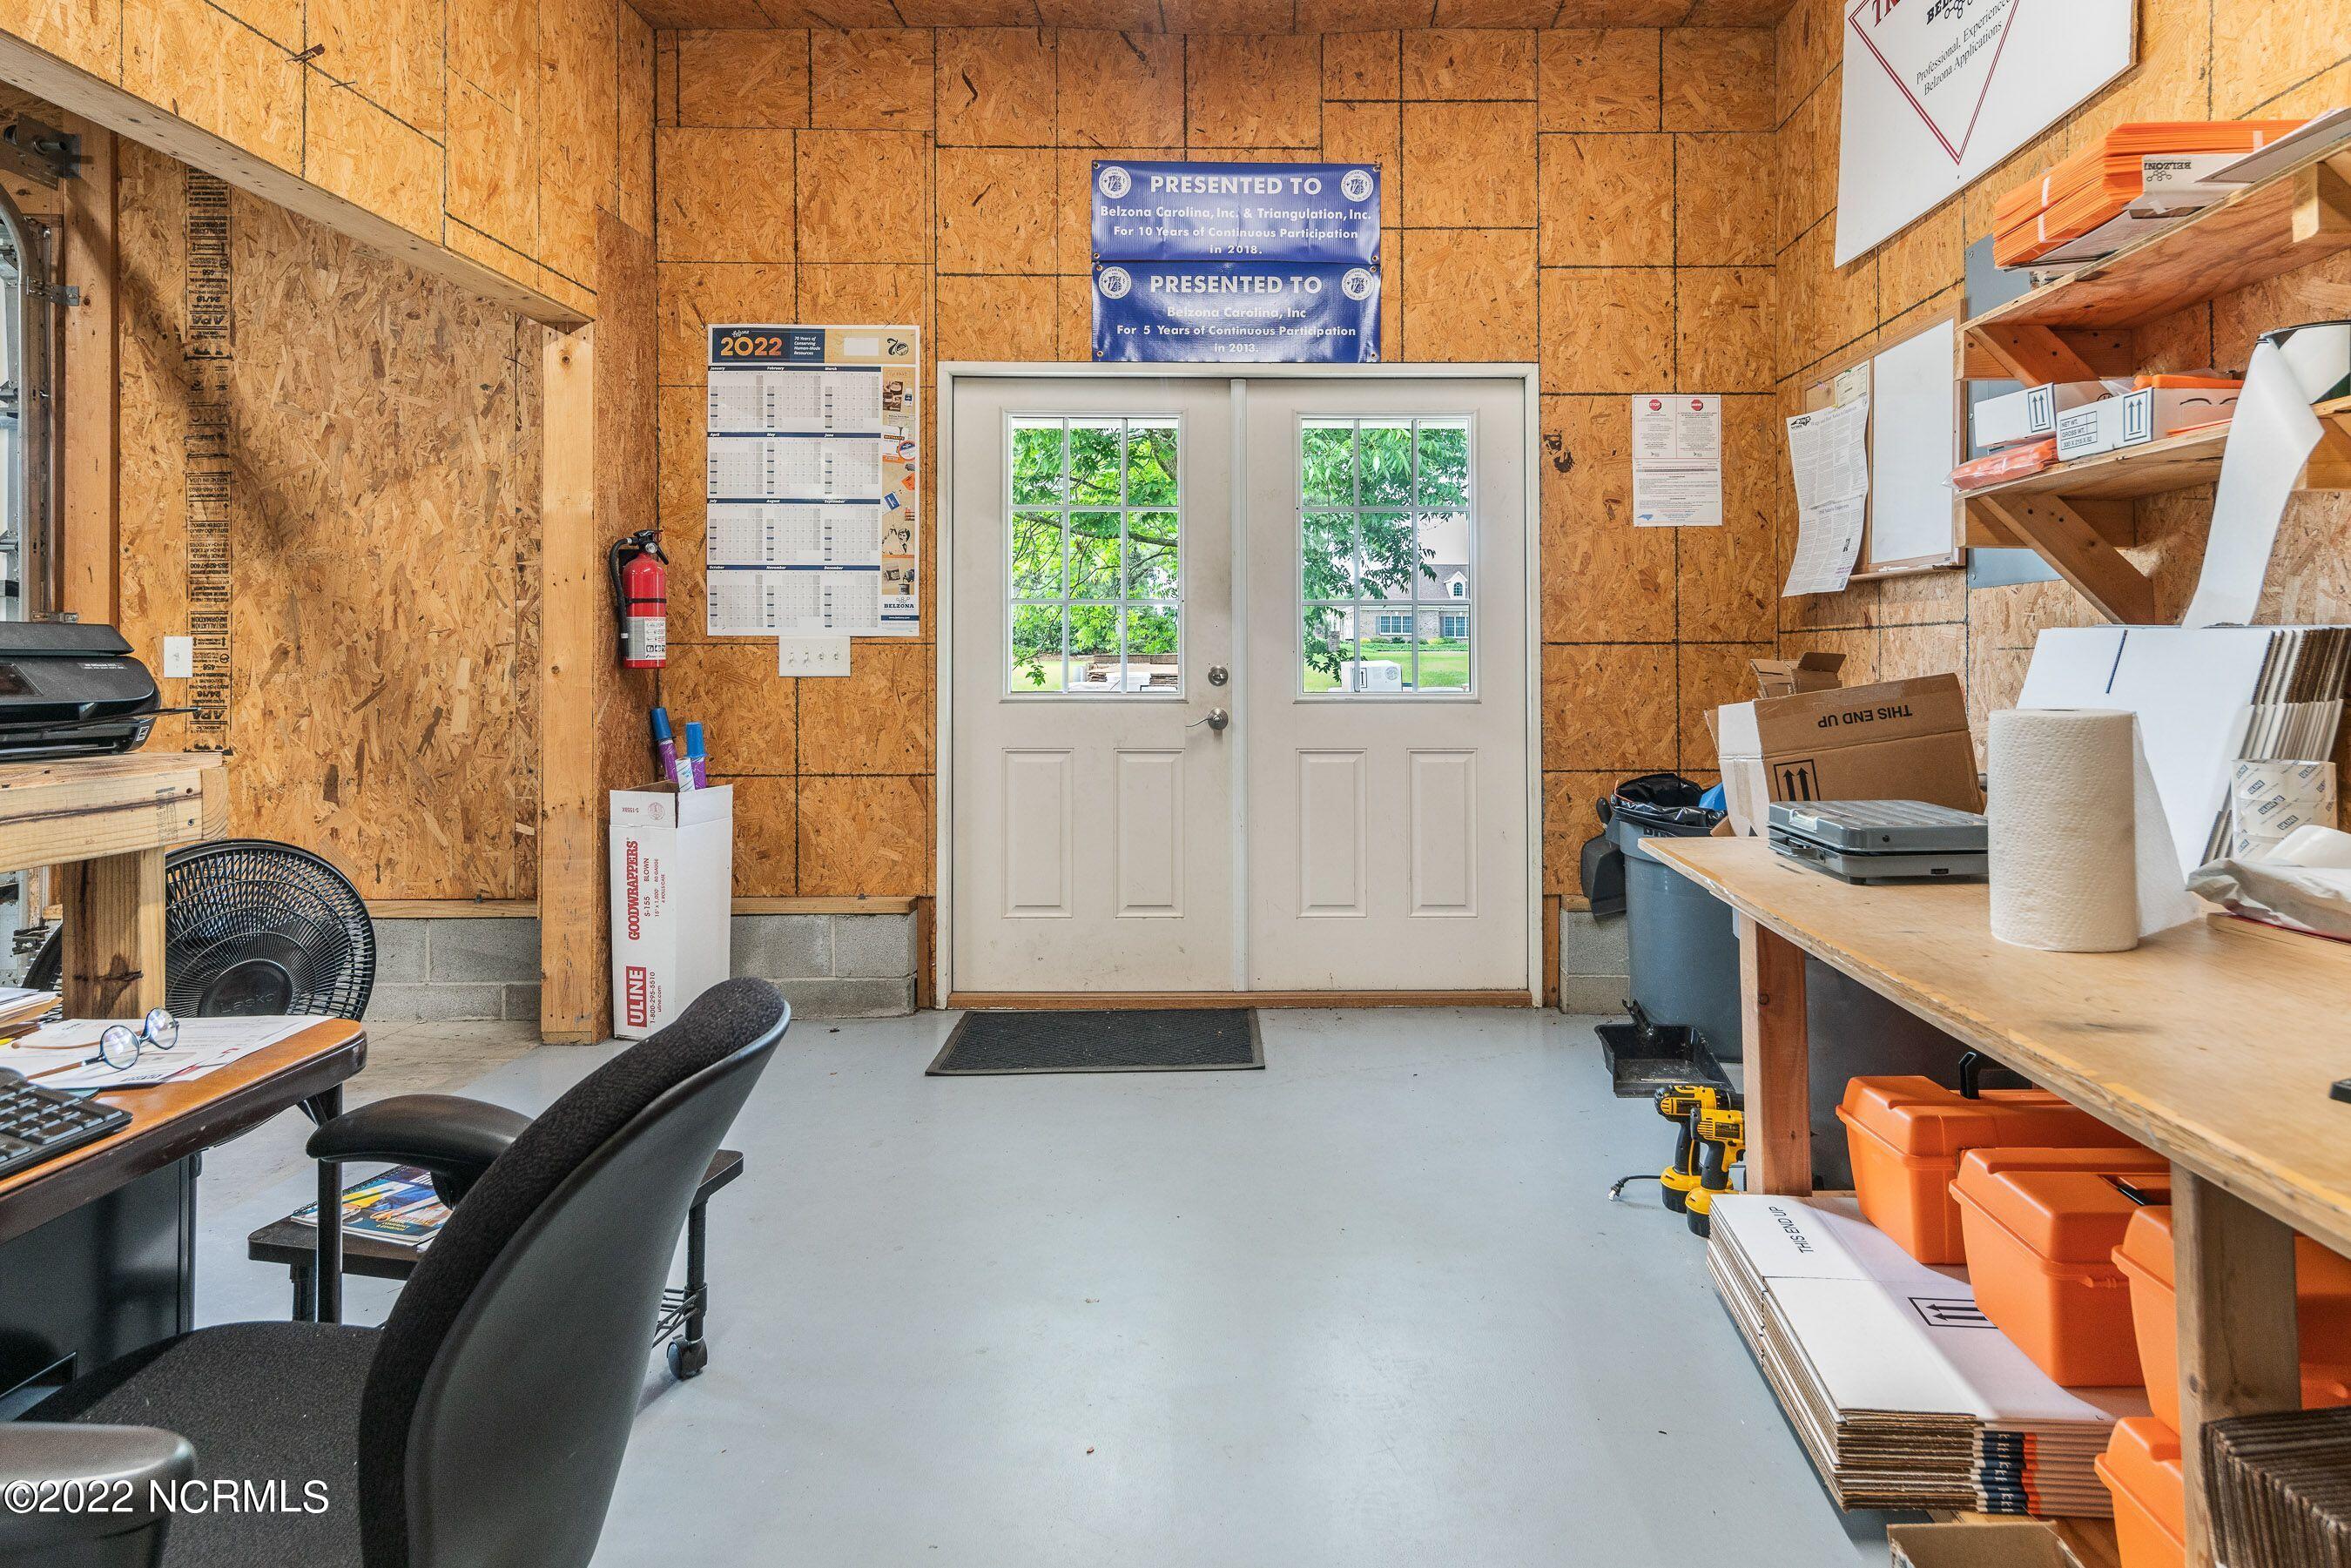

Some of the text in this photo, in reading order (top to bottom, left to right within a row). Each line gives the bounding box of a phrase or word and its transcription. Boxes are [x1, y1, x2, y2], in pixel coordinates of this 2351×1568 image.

[1923, 21, 2002, 96] Belzona Applications
[1150, 175, 1283, 195] PRESENTED
[1290, 177, 1322, 195] TO
[1101, 206, 1371, 221] Belzona Carolina, Inc. & Triangulation, Inc.
[1114, 226, 1358, 240] For 10 Years of Continuous Participation
[1210, 244, 1263, 254] in 2018.
[1150, 276, 1283, 293] PRESENTED
[1290, 277, 1323, 293] TO
[1167, 306, 1306, 319] Belzona Carolina, Inc
[1117, 325, 1356, 338] For 5 Years of Continuous Participation
[720, 337, 783, 356] 2022
[1215, 344, 1259, 353] in 2013.
[2062, 429, 2077, 438] GROSS
[1818, 705, 1913, 729] THIS END UP
[2277, 815, 2299, 831] ULINE
[626, 840, 640, 940] GOODWRAPPERS
[629, 968, 645, 1023] ULINE
[1768, 1206, 1814, 1254] THIS END UP
